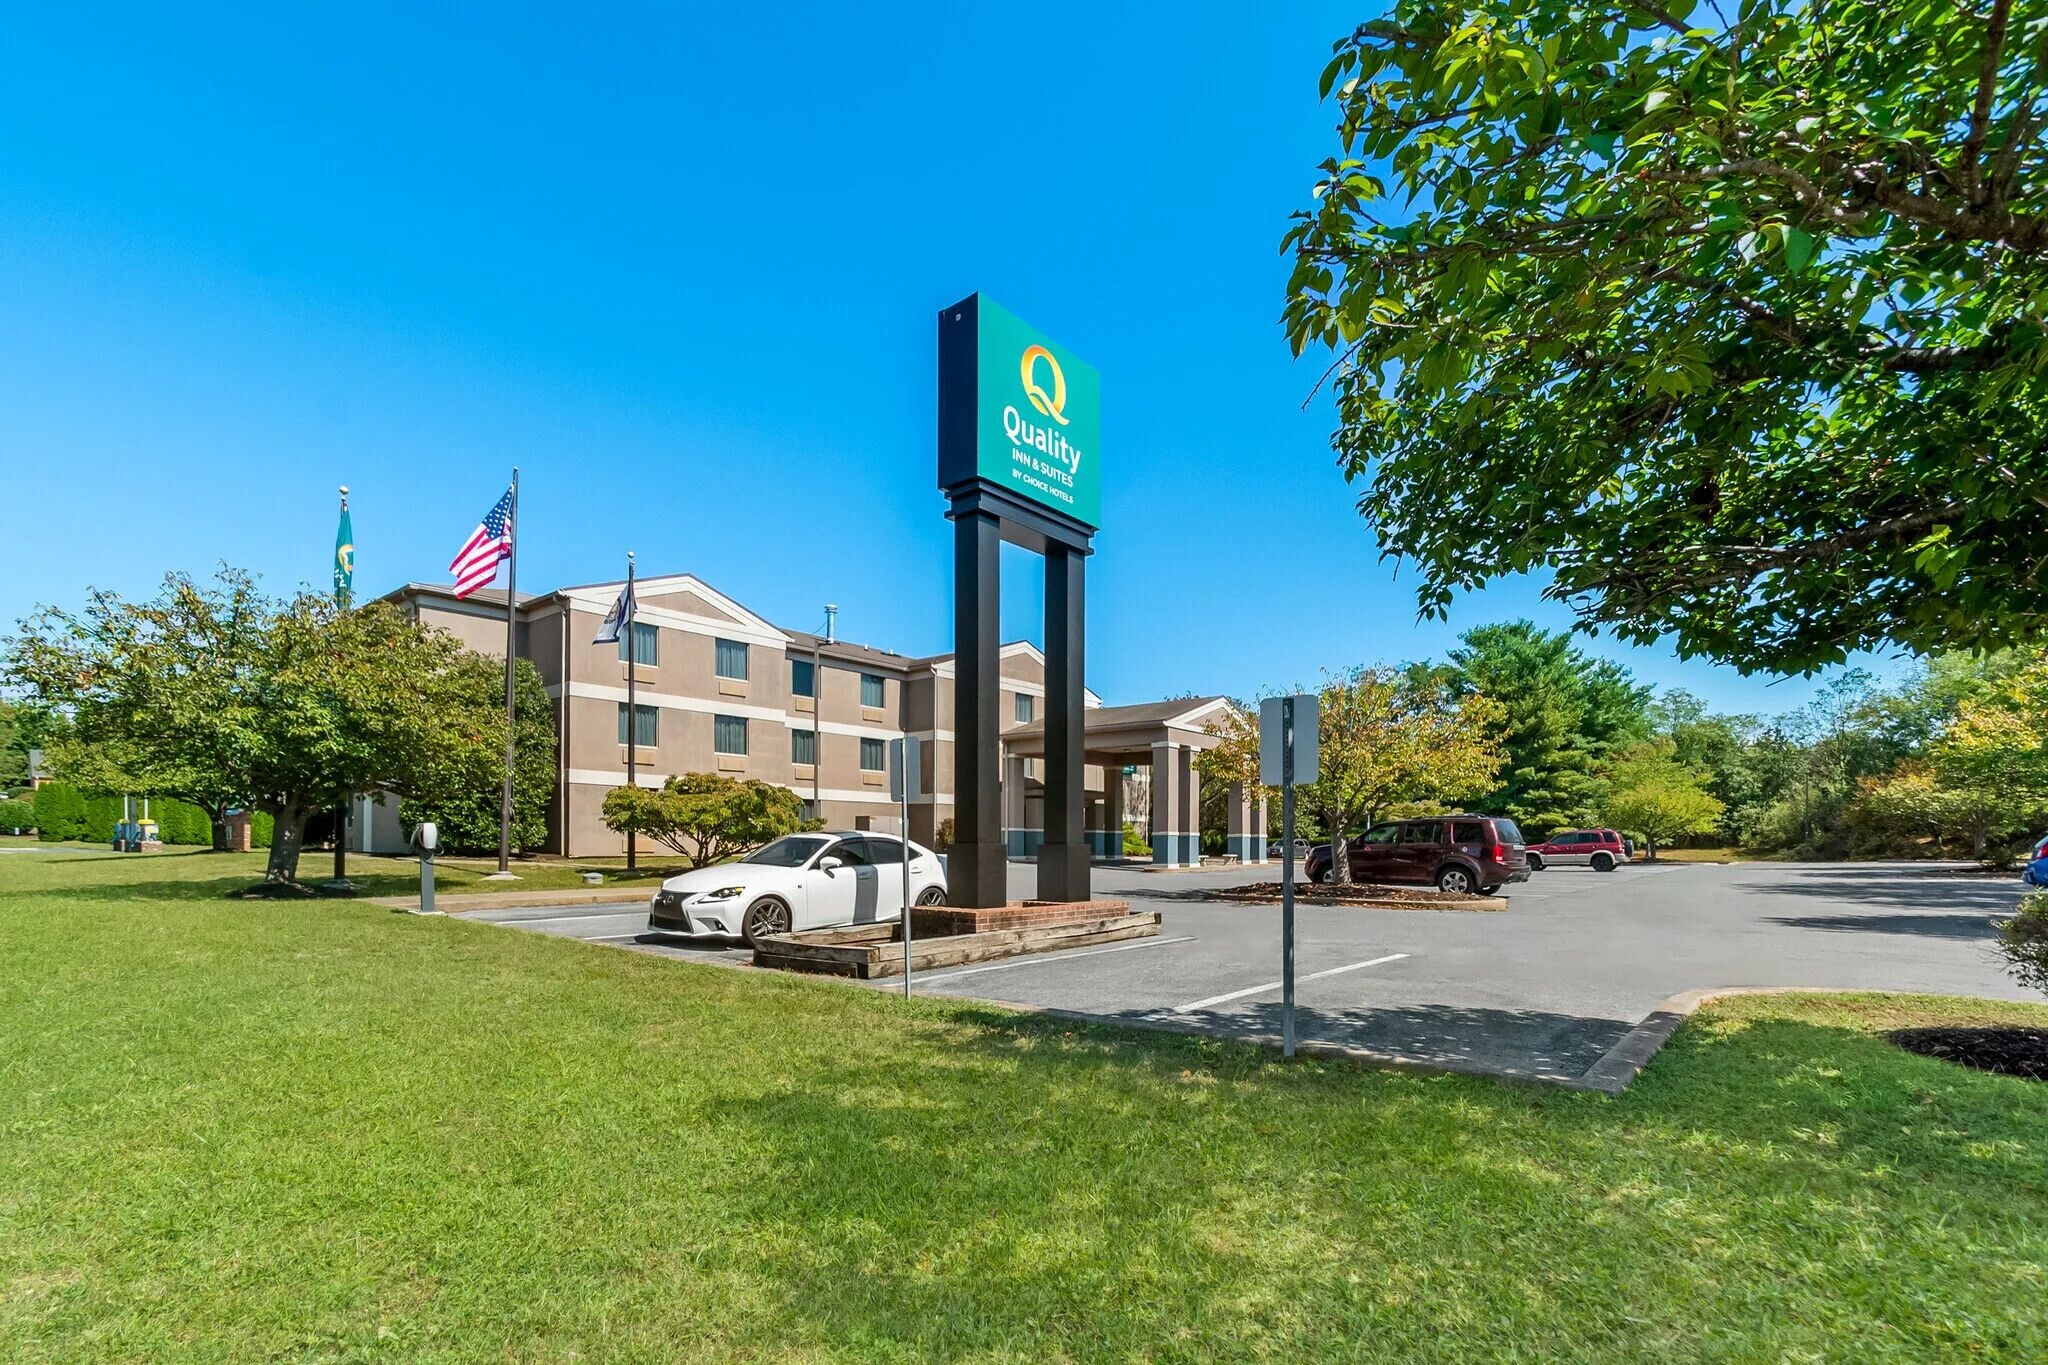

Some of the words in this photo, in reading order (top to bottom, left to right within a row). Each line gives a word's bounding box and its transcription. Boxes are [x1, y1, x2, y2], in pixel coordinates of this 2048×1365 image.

[1003, 405, 1081, 474] Quality
[1012, 448, 1031, 467] INN
[1032, 458, 1039, 471] &
[1040, 462, 1073, 488] SUITES
[1012, 469, 1022, 479] BY
[1023, 474, 1048, 492] CHOICE
[1049, 486, 1073, 504] HOTELS
